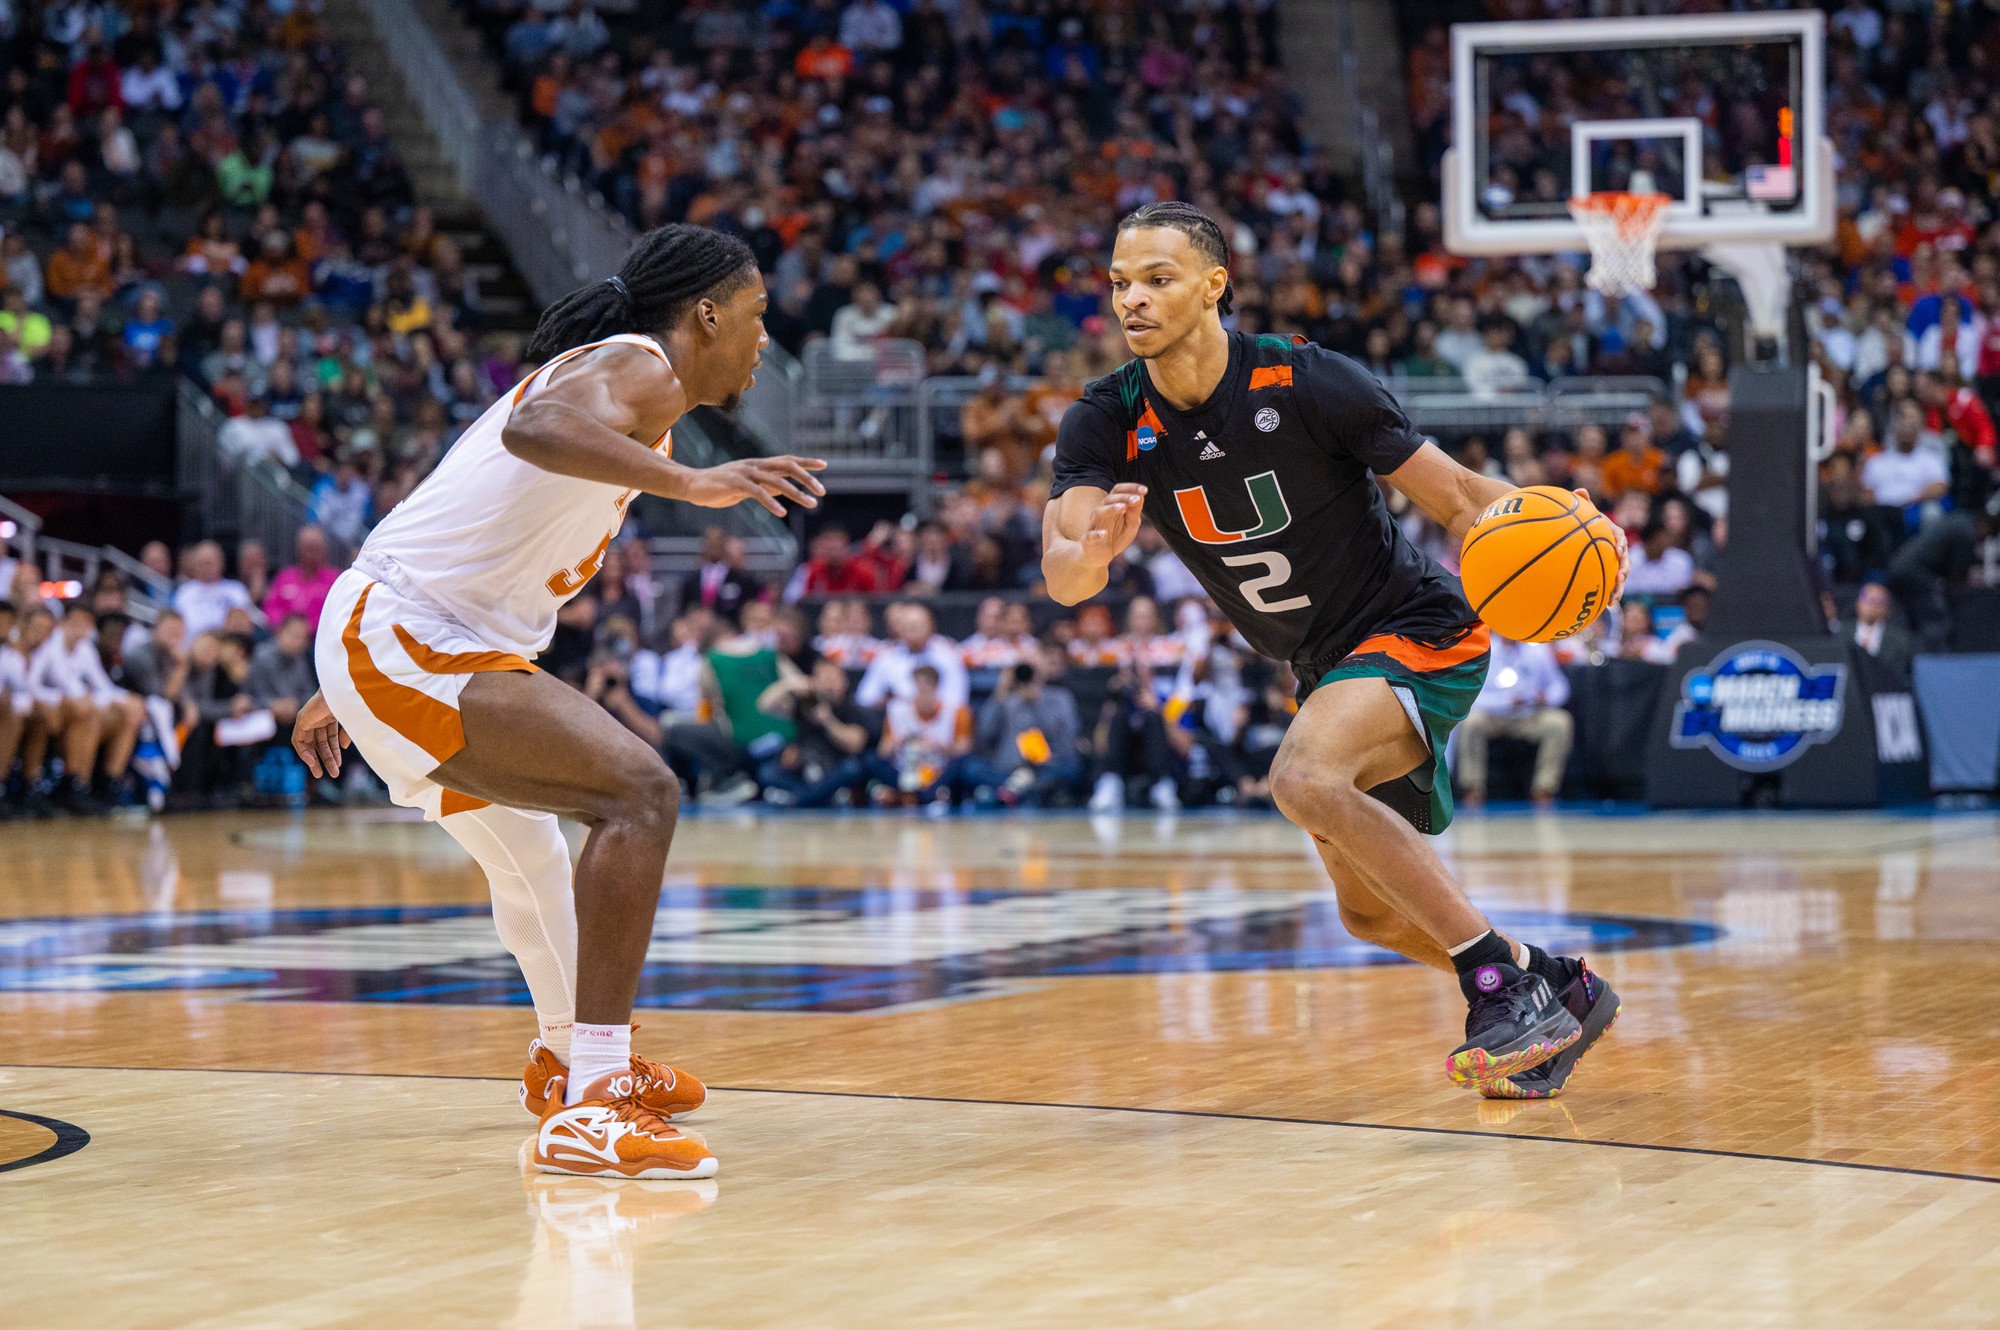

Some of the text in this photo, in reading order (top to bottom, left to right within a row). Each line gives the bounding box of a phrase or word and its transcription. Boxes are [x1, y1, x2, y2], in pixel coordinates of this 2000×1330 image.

[1137, 436, 1157, 445] NCAA
[1199, 450, 1226, 461] adidas
[1173, 470, 1292, 545] U
[1220, 551, 1312, 613] 2
